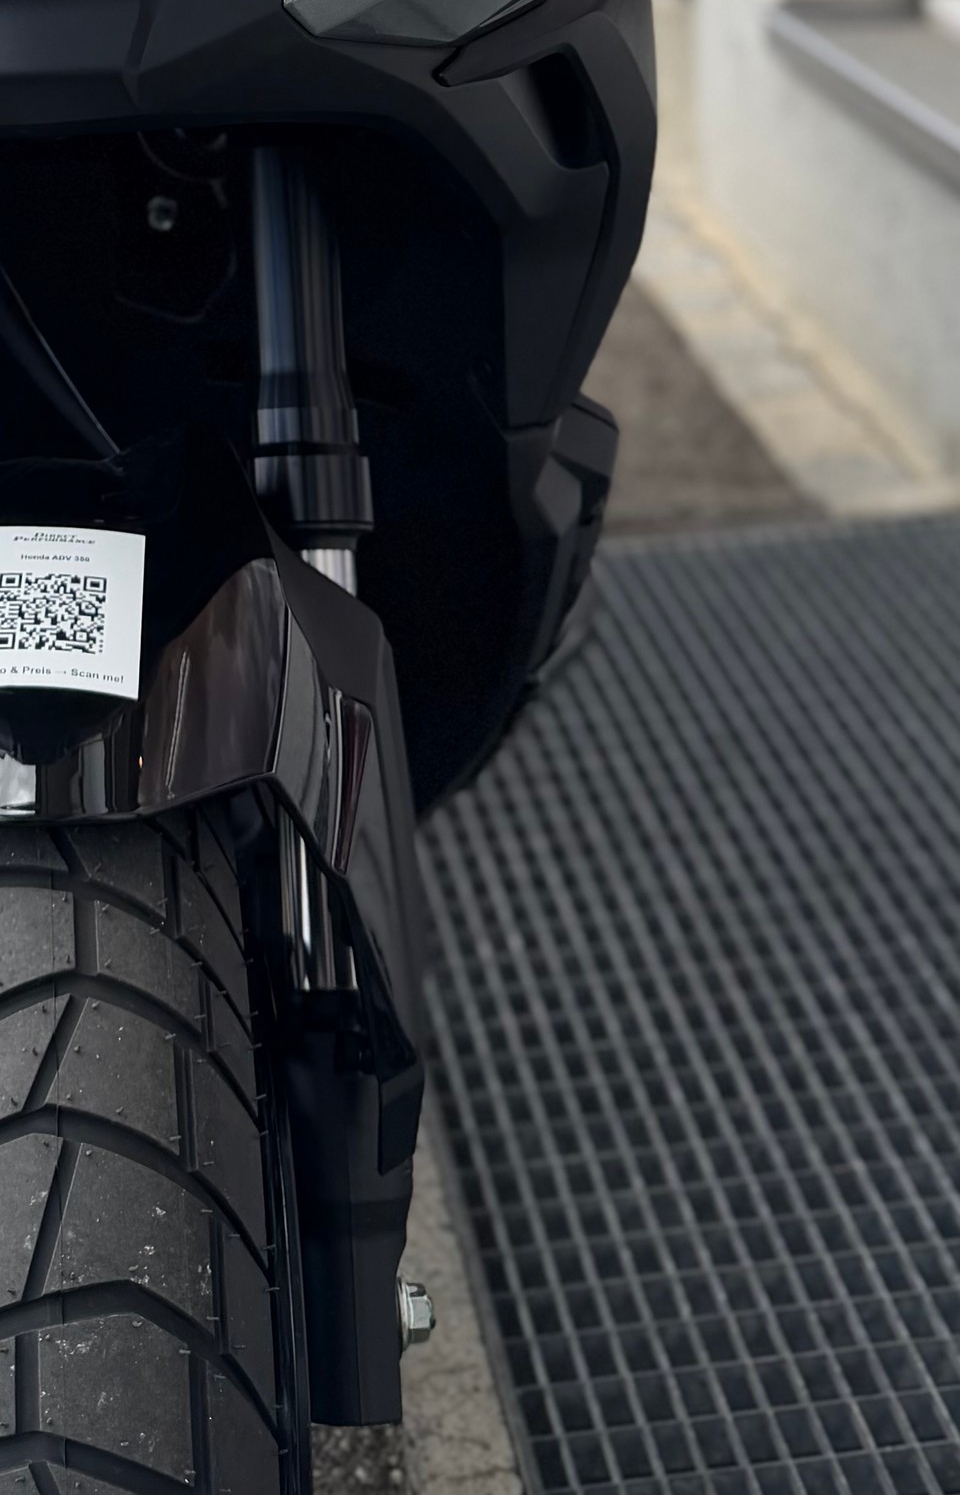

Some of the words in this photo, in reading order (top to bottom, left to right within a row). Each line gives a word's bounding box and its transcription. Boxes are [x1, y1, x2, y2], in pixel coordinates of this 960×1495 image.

[20, 553, 50, 561] Honda
[10, 665, 19, 675] &
[22, 665, 52, 675] Preis
[71, 667, 100, 680] Scan
[102, 674, 125, 684] me!
